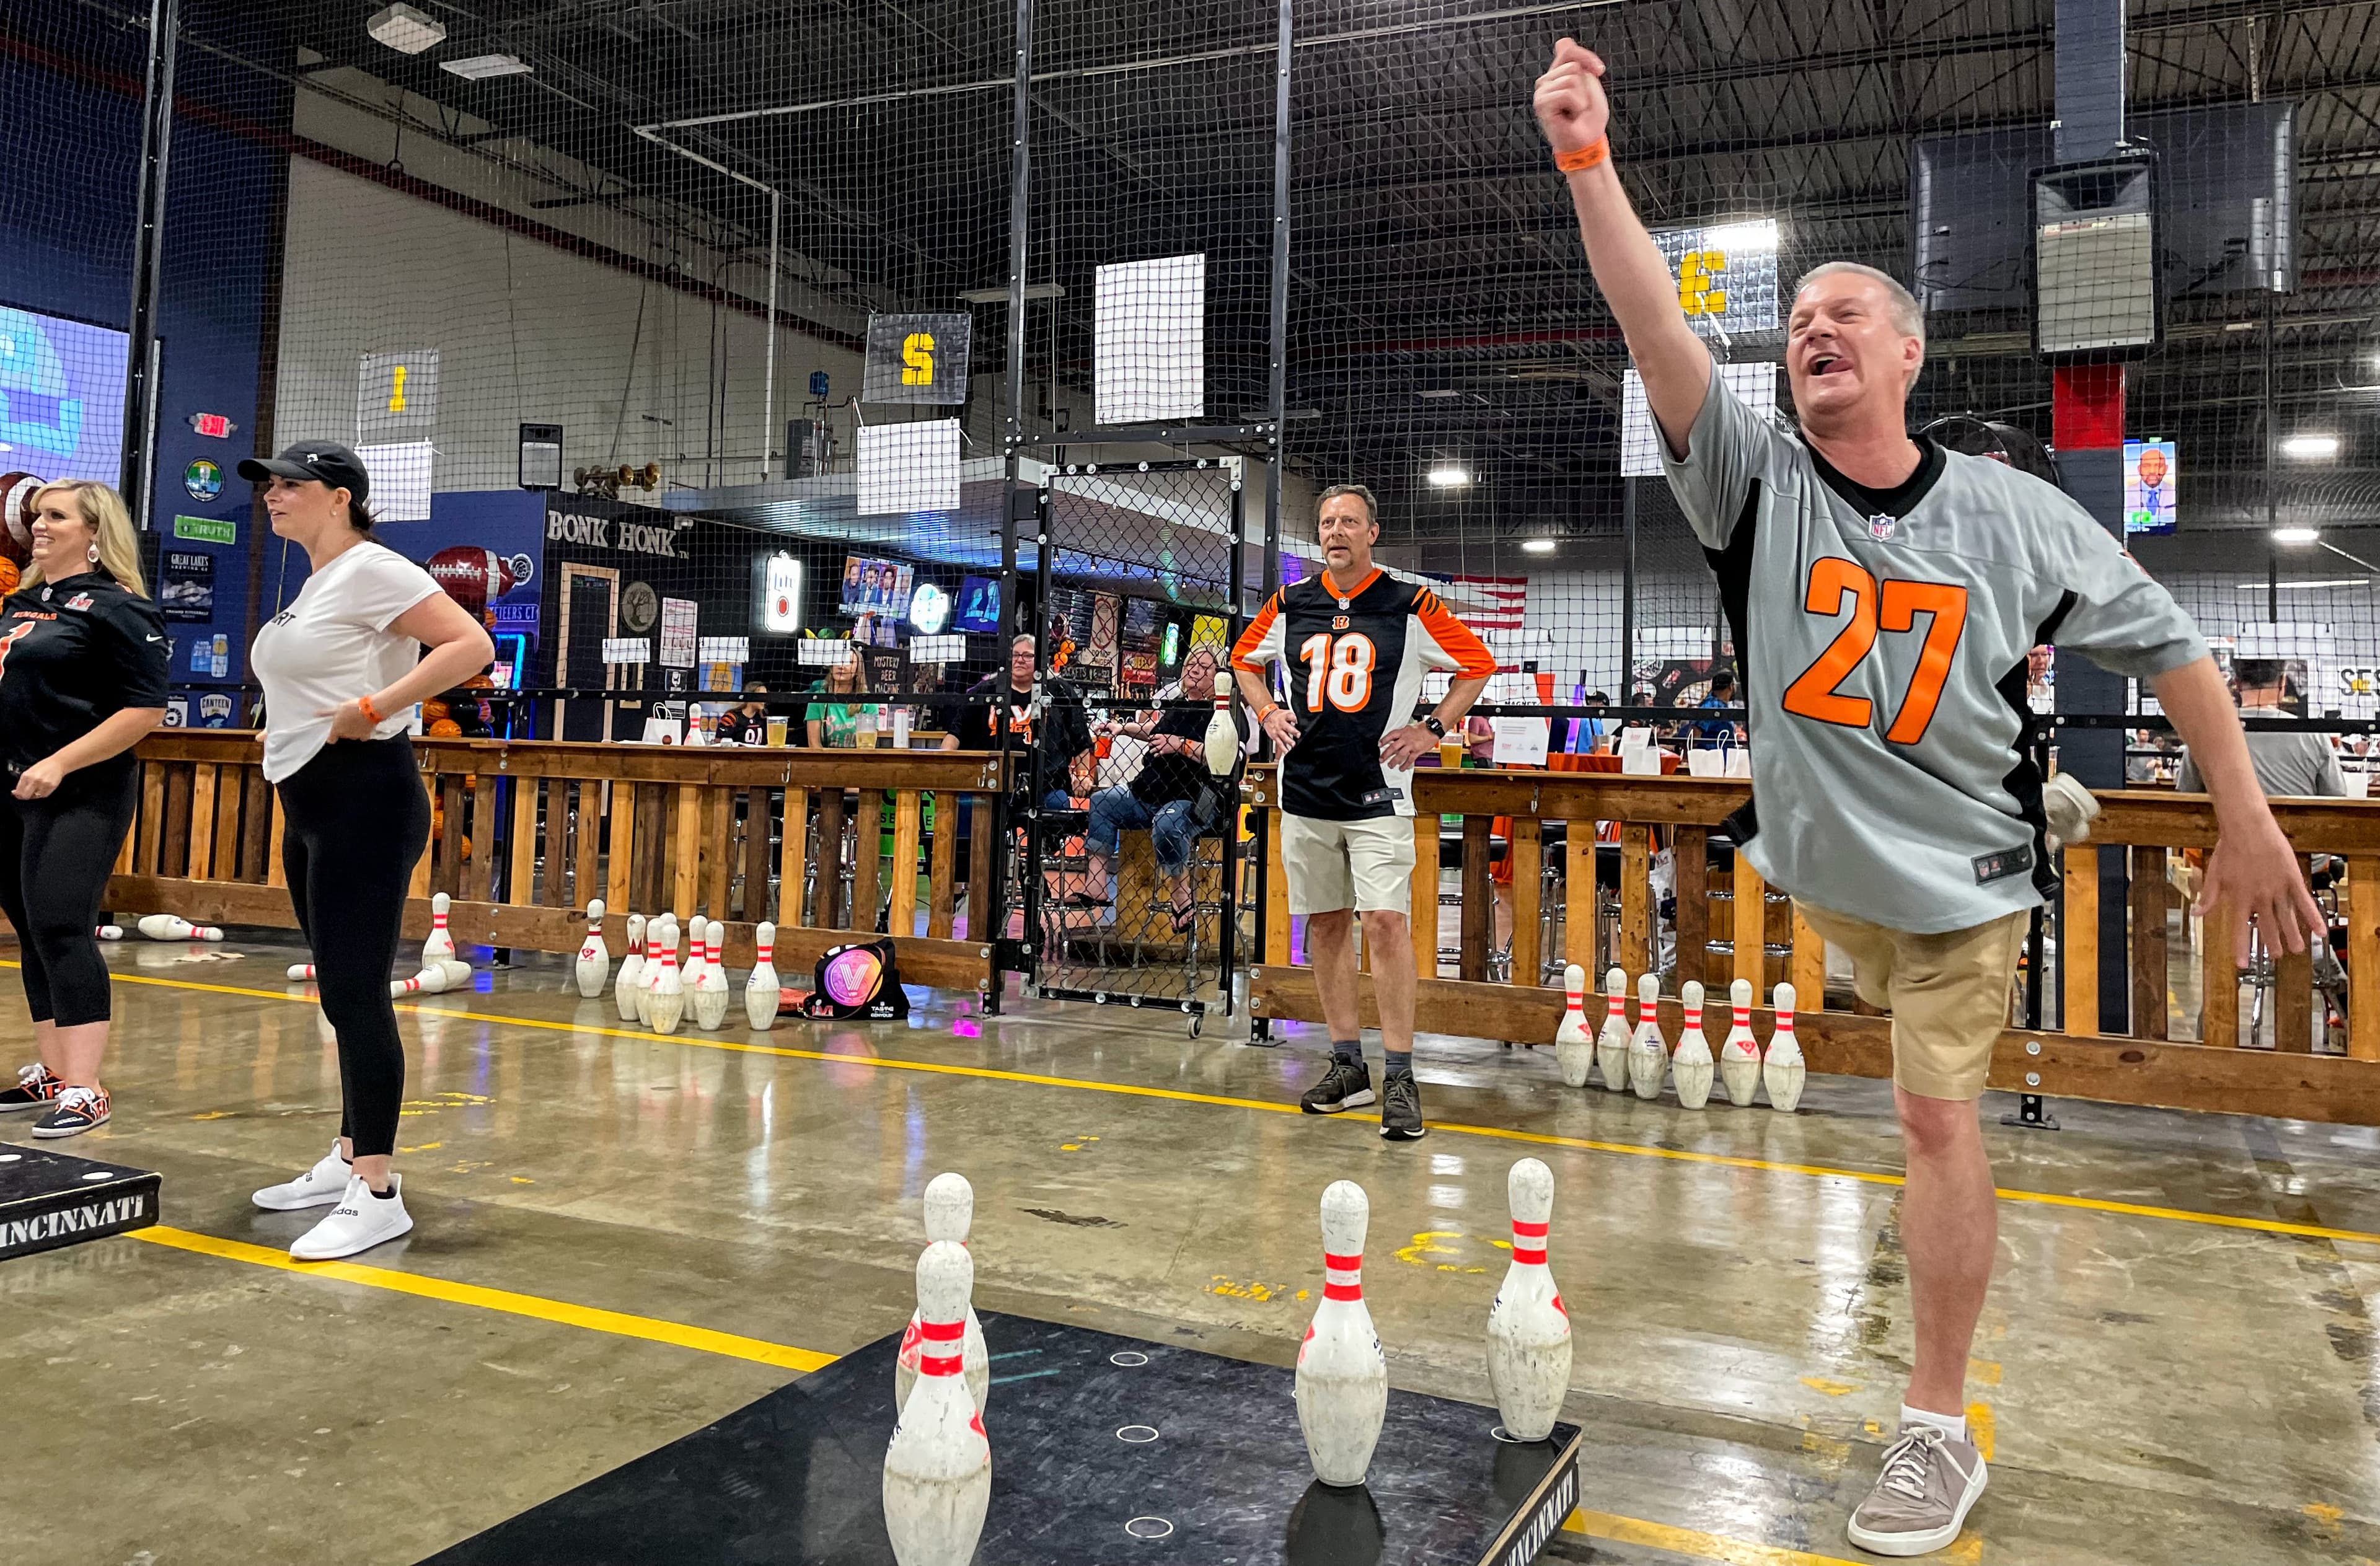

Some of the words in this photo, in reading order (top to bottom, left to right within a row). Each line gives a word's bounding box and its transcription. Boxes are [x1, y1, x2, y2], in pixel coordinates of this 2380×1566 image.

[547, 510, 609, 548] BONK
[618, 522, 676, 557] HONK
[190, 555, 209, 566] LAKES
[12, 611, 58, 620] BENGALS
[1783, 556, 1967, 744] 27
[873, 656, 900, 669] MYSTERY
[880, 669, 897, 681] BEER
[1300, 632, 1376, 713] 18
[874, 682, 900, 694] MACHINE
[202, 698, 230, 709] CANTEEN
